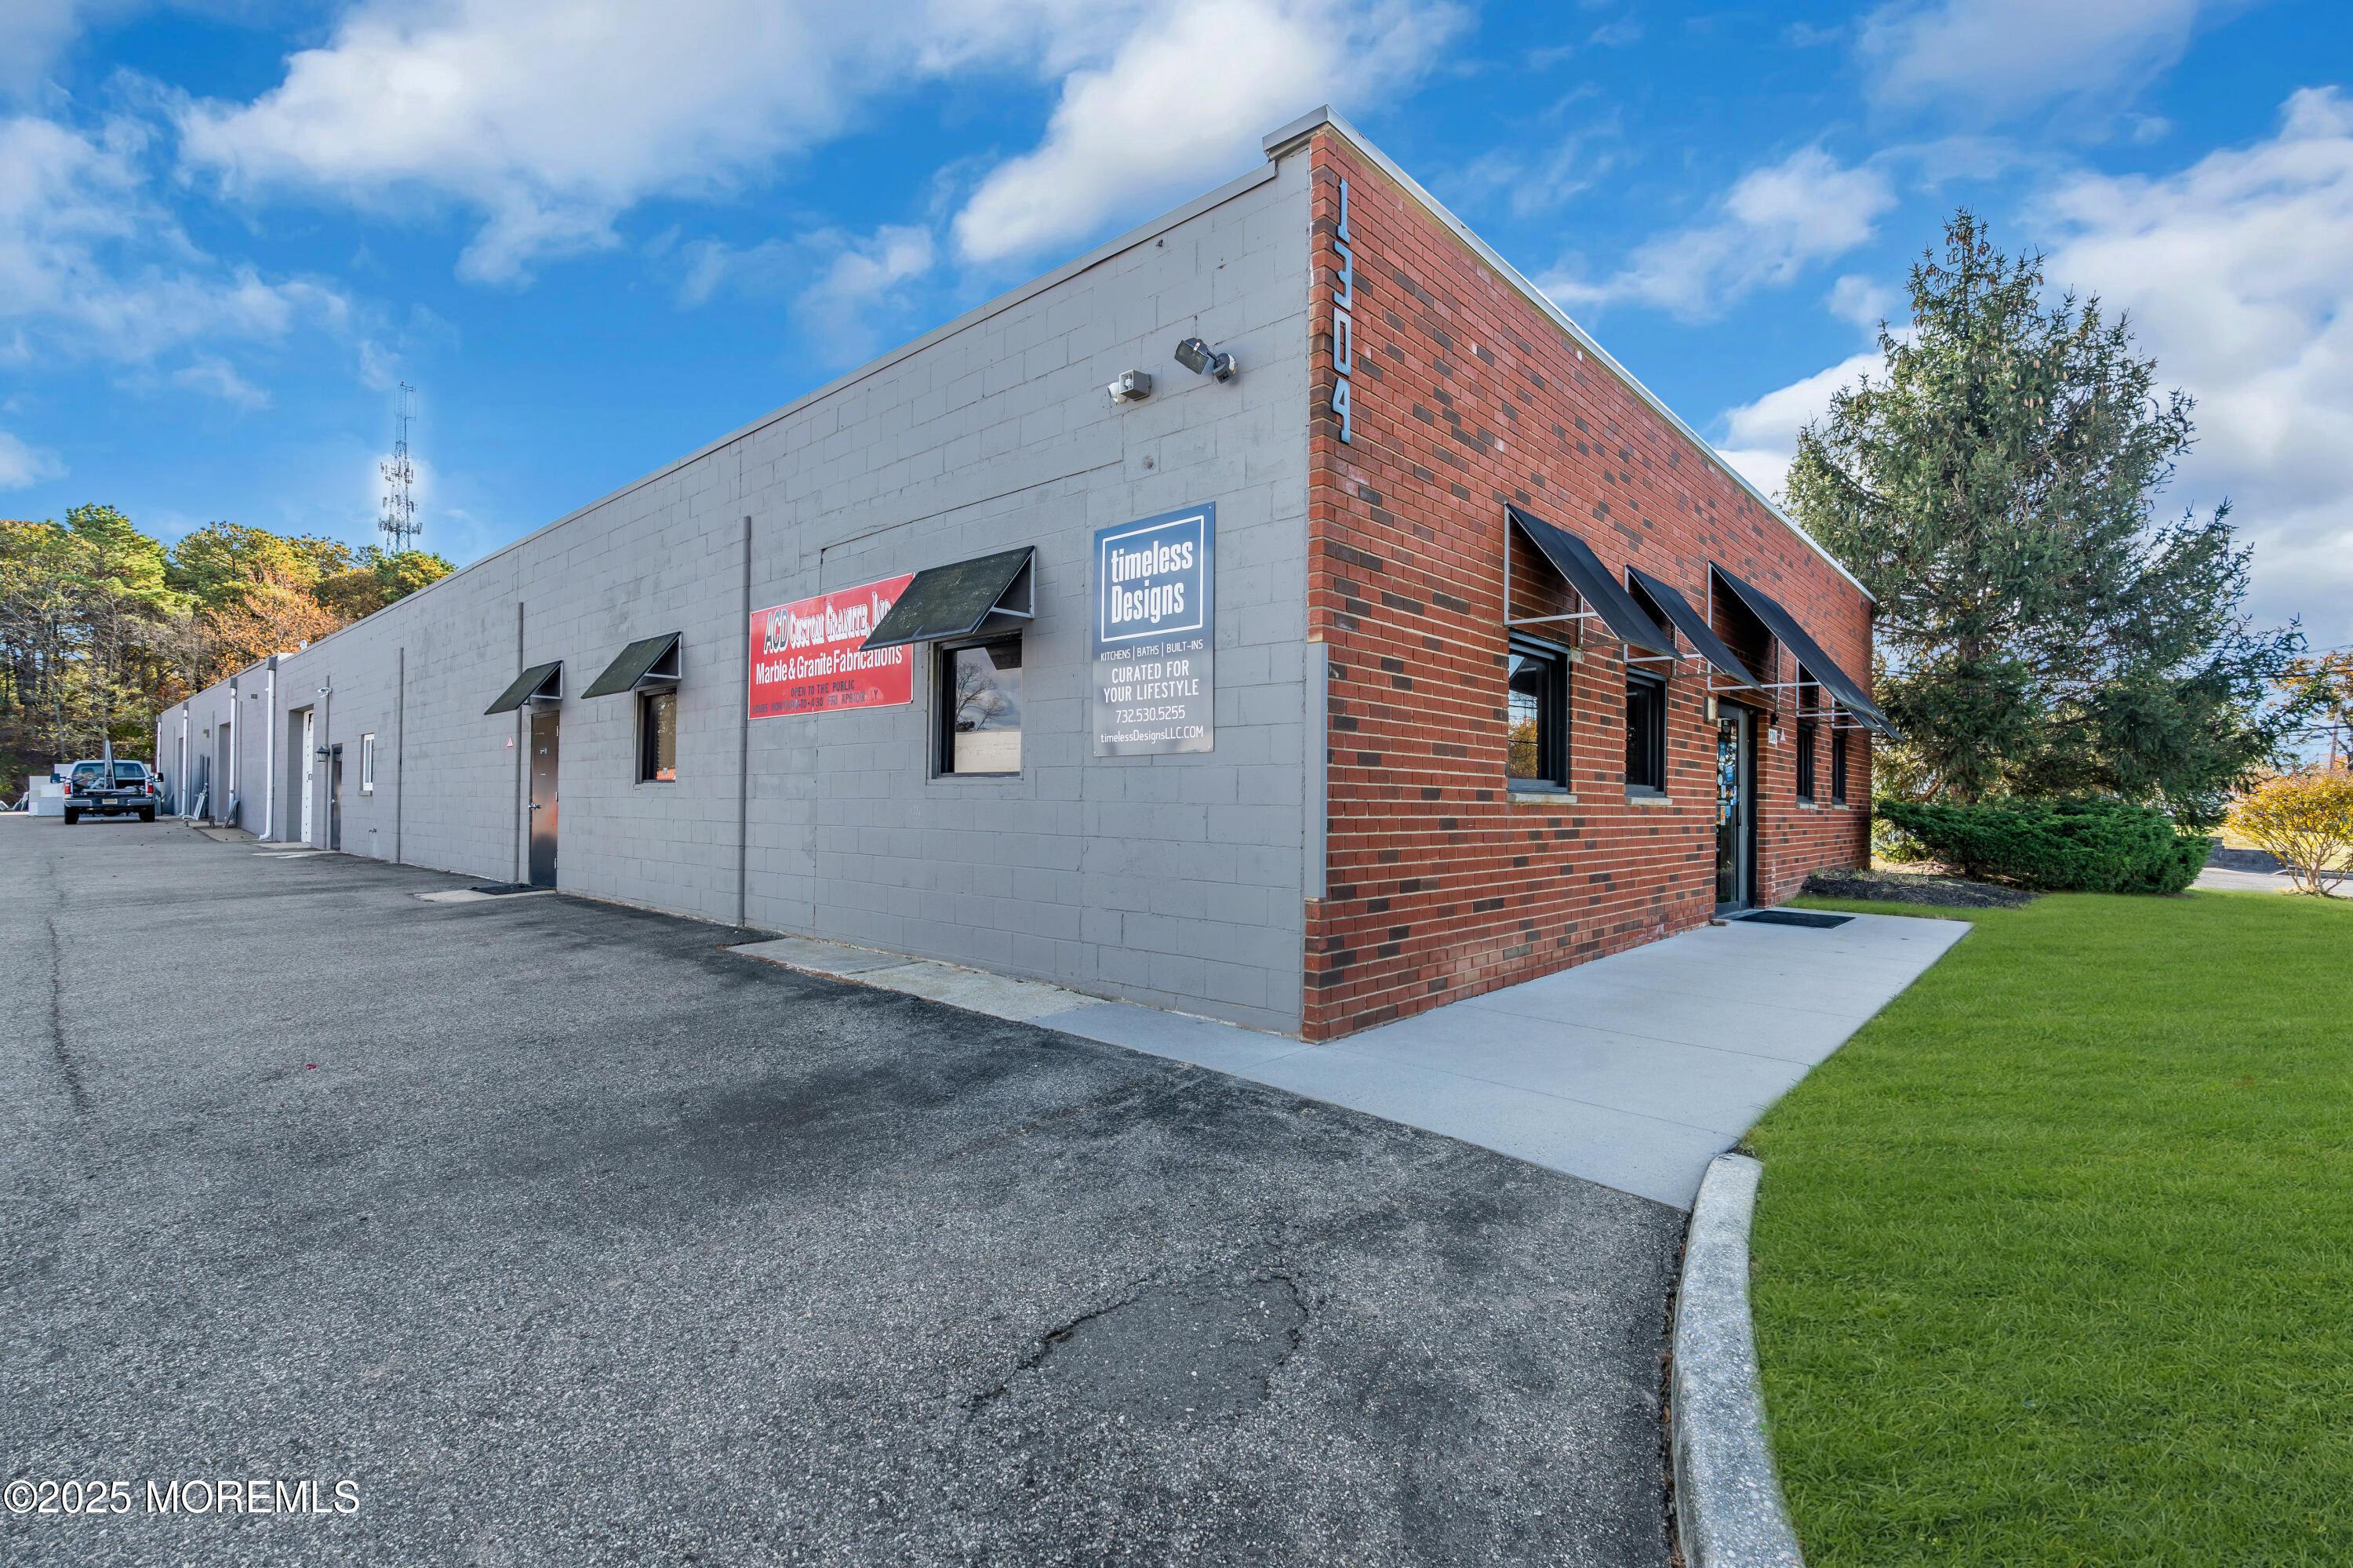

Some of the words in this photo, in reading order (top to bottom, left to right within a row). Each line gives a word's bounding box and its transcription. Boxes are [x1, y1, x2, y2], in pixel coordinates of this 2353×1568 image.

[1333, 178, 1353, 445] 1304
[1111, 540, 1194, 583] timeless
[1111, 580, 1184, 624] Designs
[763, 609, 789, 654] ACD
[1100, 649, 1131, 661] KITCHENS
[1136, 646, 1159, 657] BATHS
[1166, 639, 1203, 653] BUILT-INS
[756, 659, 787, 685] Marble
[788, 657, 796, 680] &
[797, 652, 834, 679] Granite
[834, 645, 903, 674] Fabrications
[1111, 663, 1162, 683] CURATED
[1166, 660, 1189, 678] FOR
[791, 687, 806, 697] OPEN
[808, 686, 815, 695] TO
[817, 683, 828, 693] THE
[832, 679, 855, 691] PUBLIC
[1104, 686, 1132, 703] YOUR
[1136, 678, 1199, 700] LIFESTYLE
[1115, 705, 1185, 723] 732.530.5255
[1100, 726, 1204, 744] timelessDesignsLLC.COM
